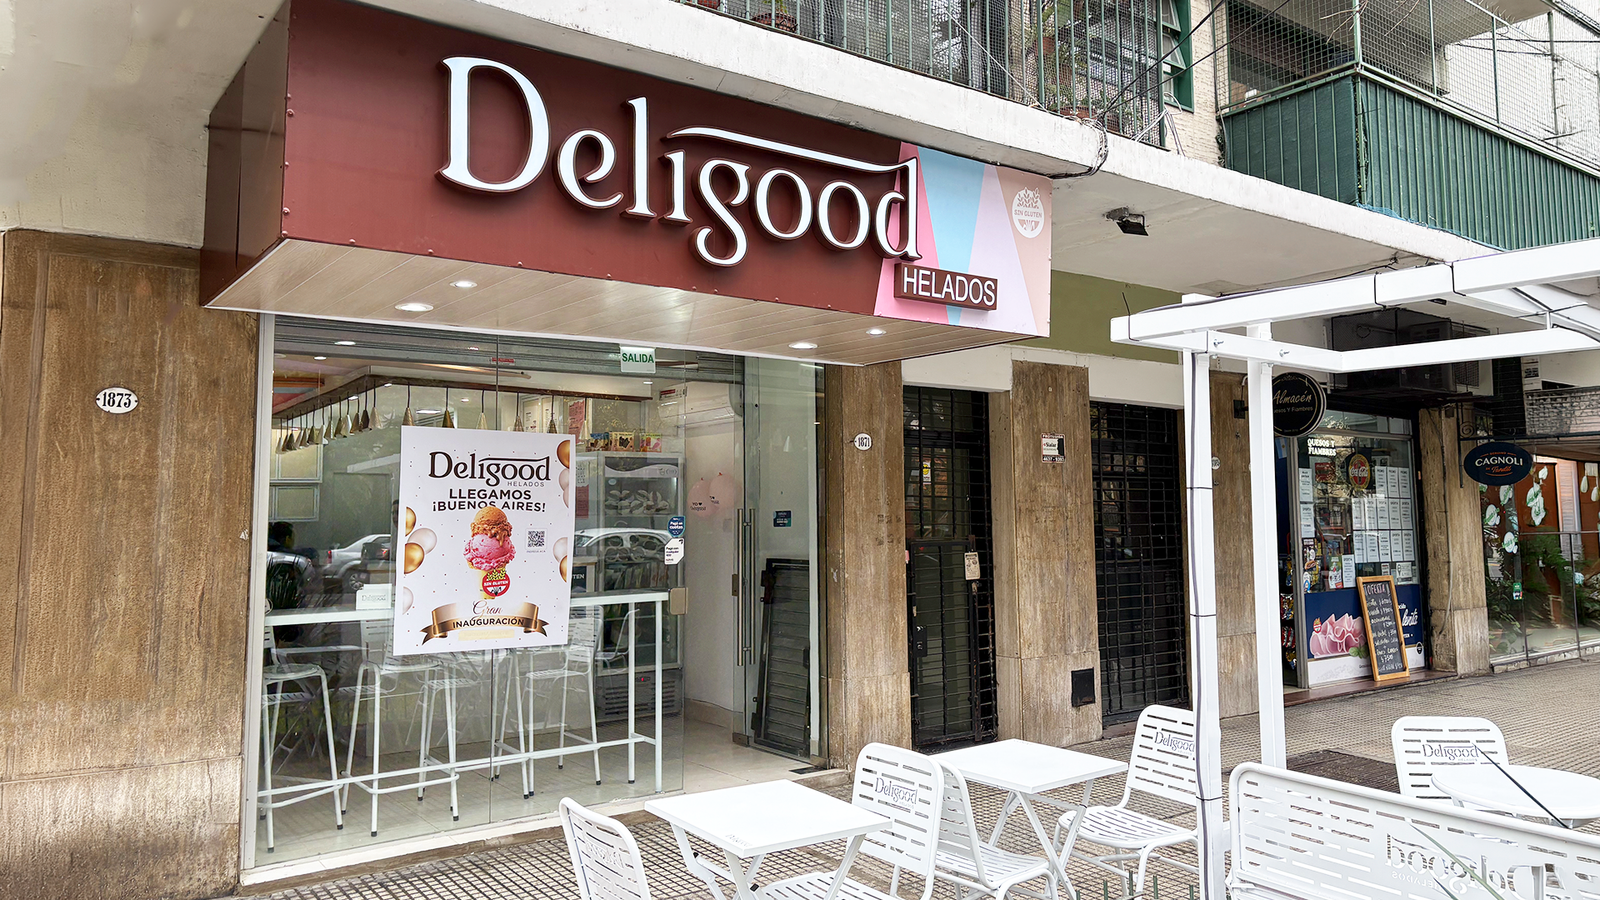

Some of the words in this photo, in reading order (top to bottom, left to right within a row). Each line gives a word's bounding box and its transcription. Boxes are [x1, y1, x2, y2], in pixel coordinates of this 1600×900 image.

[437, 56, 922, 268] Deligood
[1024, 210, 1042, 218] GLUTEN
[903, 266, 996, 306] HELADOS
[621, 352, 654, 364] SALIDA
[102, 391, 132, 408] 1873
[858, 436, 870, 447] 1871
[1307, 438, 1329, 447] QUESOS
[1330, 440, 1335, 448] Y
[1308, 447, 1336, 456] FIAMBRES
[1475, 456, 1523, 467] CAGNOLI
[428, 451, 551, 487] Deligood
[449, 488, 531, 500] LLEGAMOS
[502, 501, 546, 512] AIRES!
[472, 600, 503, 618] Gran
[452, 616, 525, 629] INAUGURACIÓN
[1422, 743, 1480, 761] Deligood
[874, 777, 918, 804] Deligood
